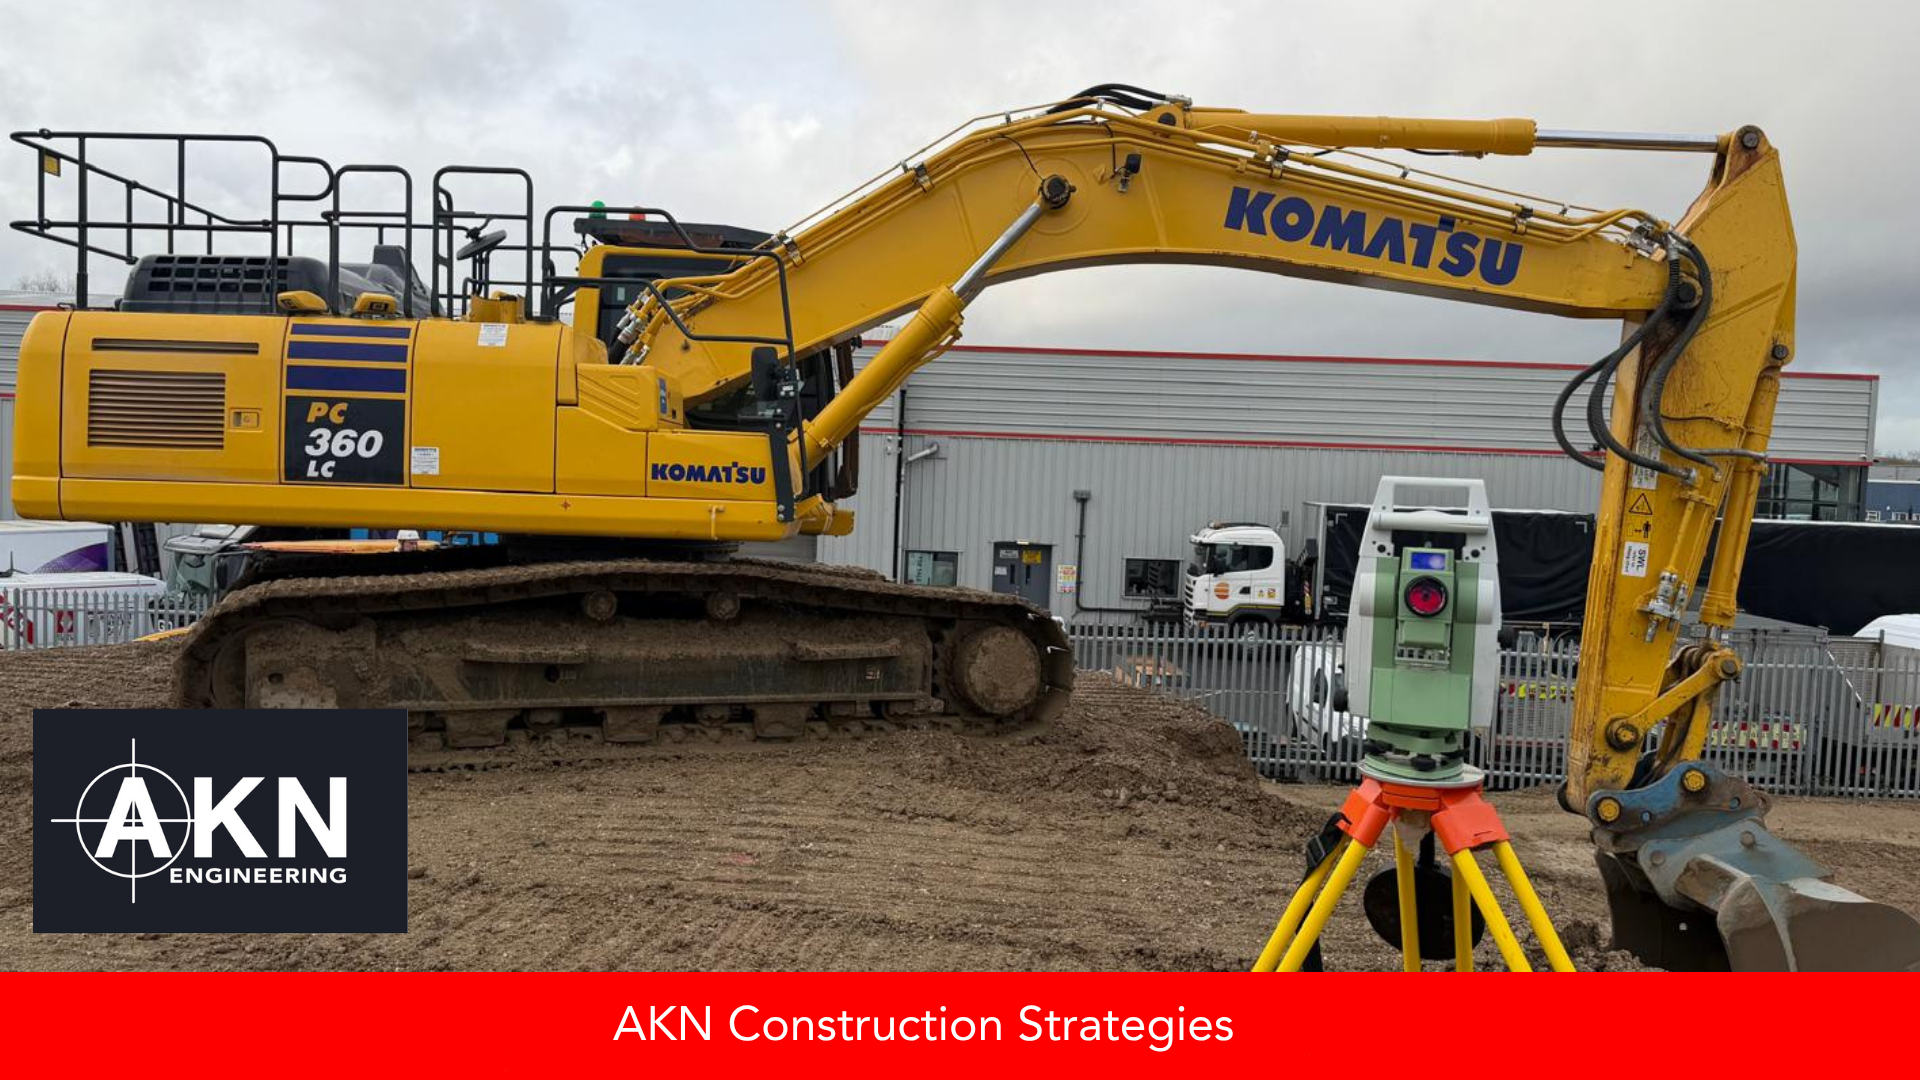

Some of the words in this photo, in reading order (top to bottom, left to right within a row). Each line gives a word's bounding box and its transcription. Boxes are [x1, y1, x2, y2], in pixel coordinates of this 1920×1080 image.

[1224, 185, 1523, 286] KOMATSU
[306, 402, 348, 424] PC
[304, 427, 384, 459] 360
[306, 460, 336, 478] LC
[651, 462, 766, 484] KOMATSU
